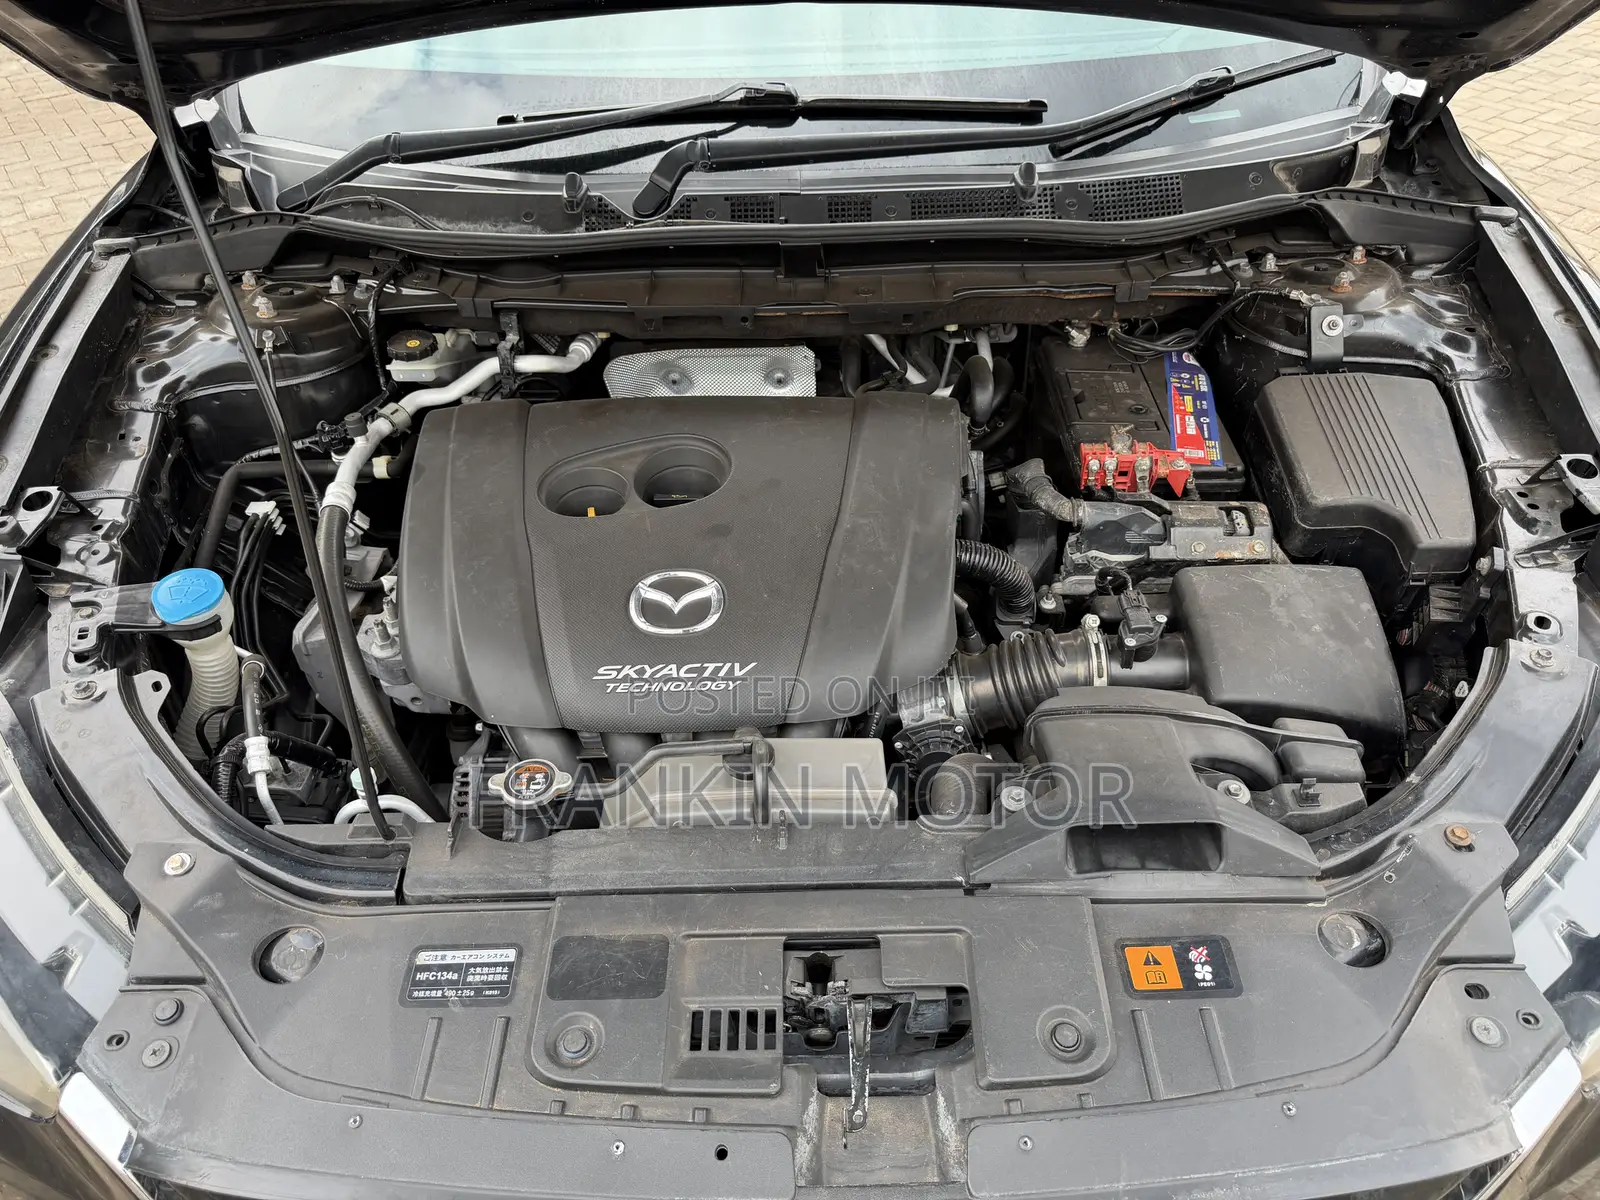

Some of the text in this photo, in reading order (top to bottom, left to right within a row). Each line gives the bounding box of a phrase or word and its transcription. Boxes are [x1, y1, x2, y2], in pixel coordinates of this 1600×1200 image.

[592, 662, 758, 680] SKYACTIV
[605, 680, 743, 694] TECHNOLOGY
[423, 953, 448, 962] ご注意
[450, 953, 485, 961] カーエアコン
[415, 971, 459, 981] HFC134a
